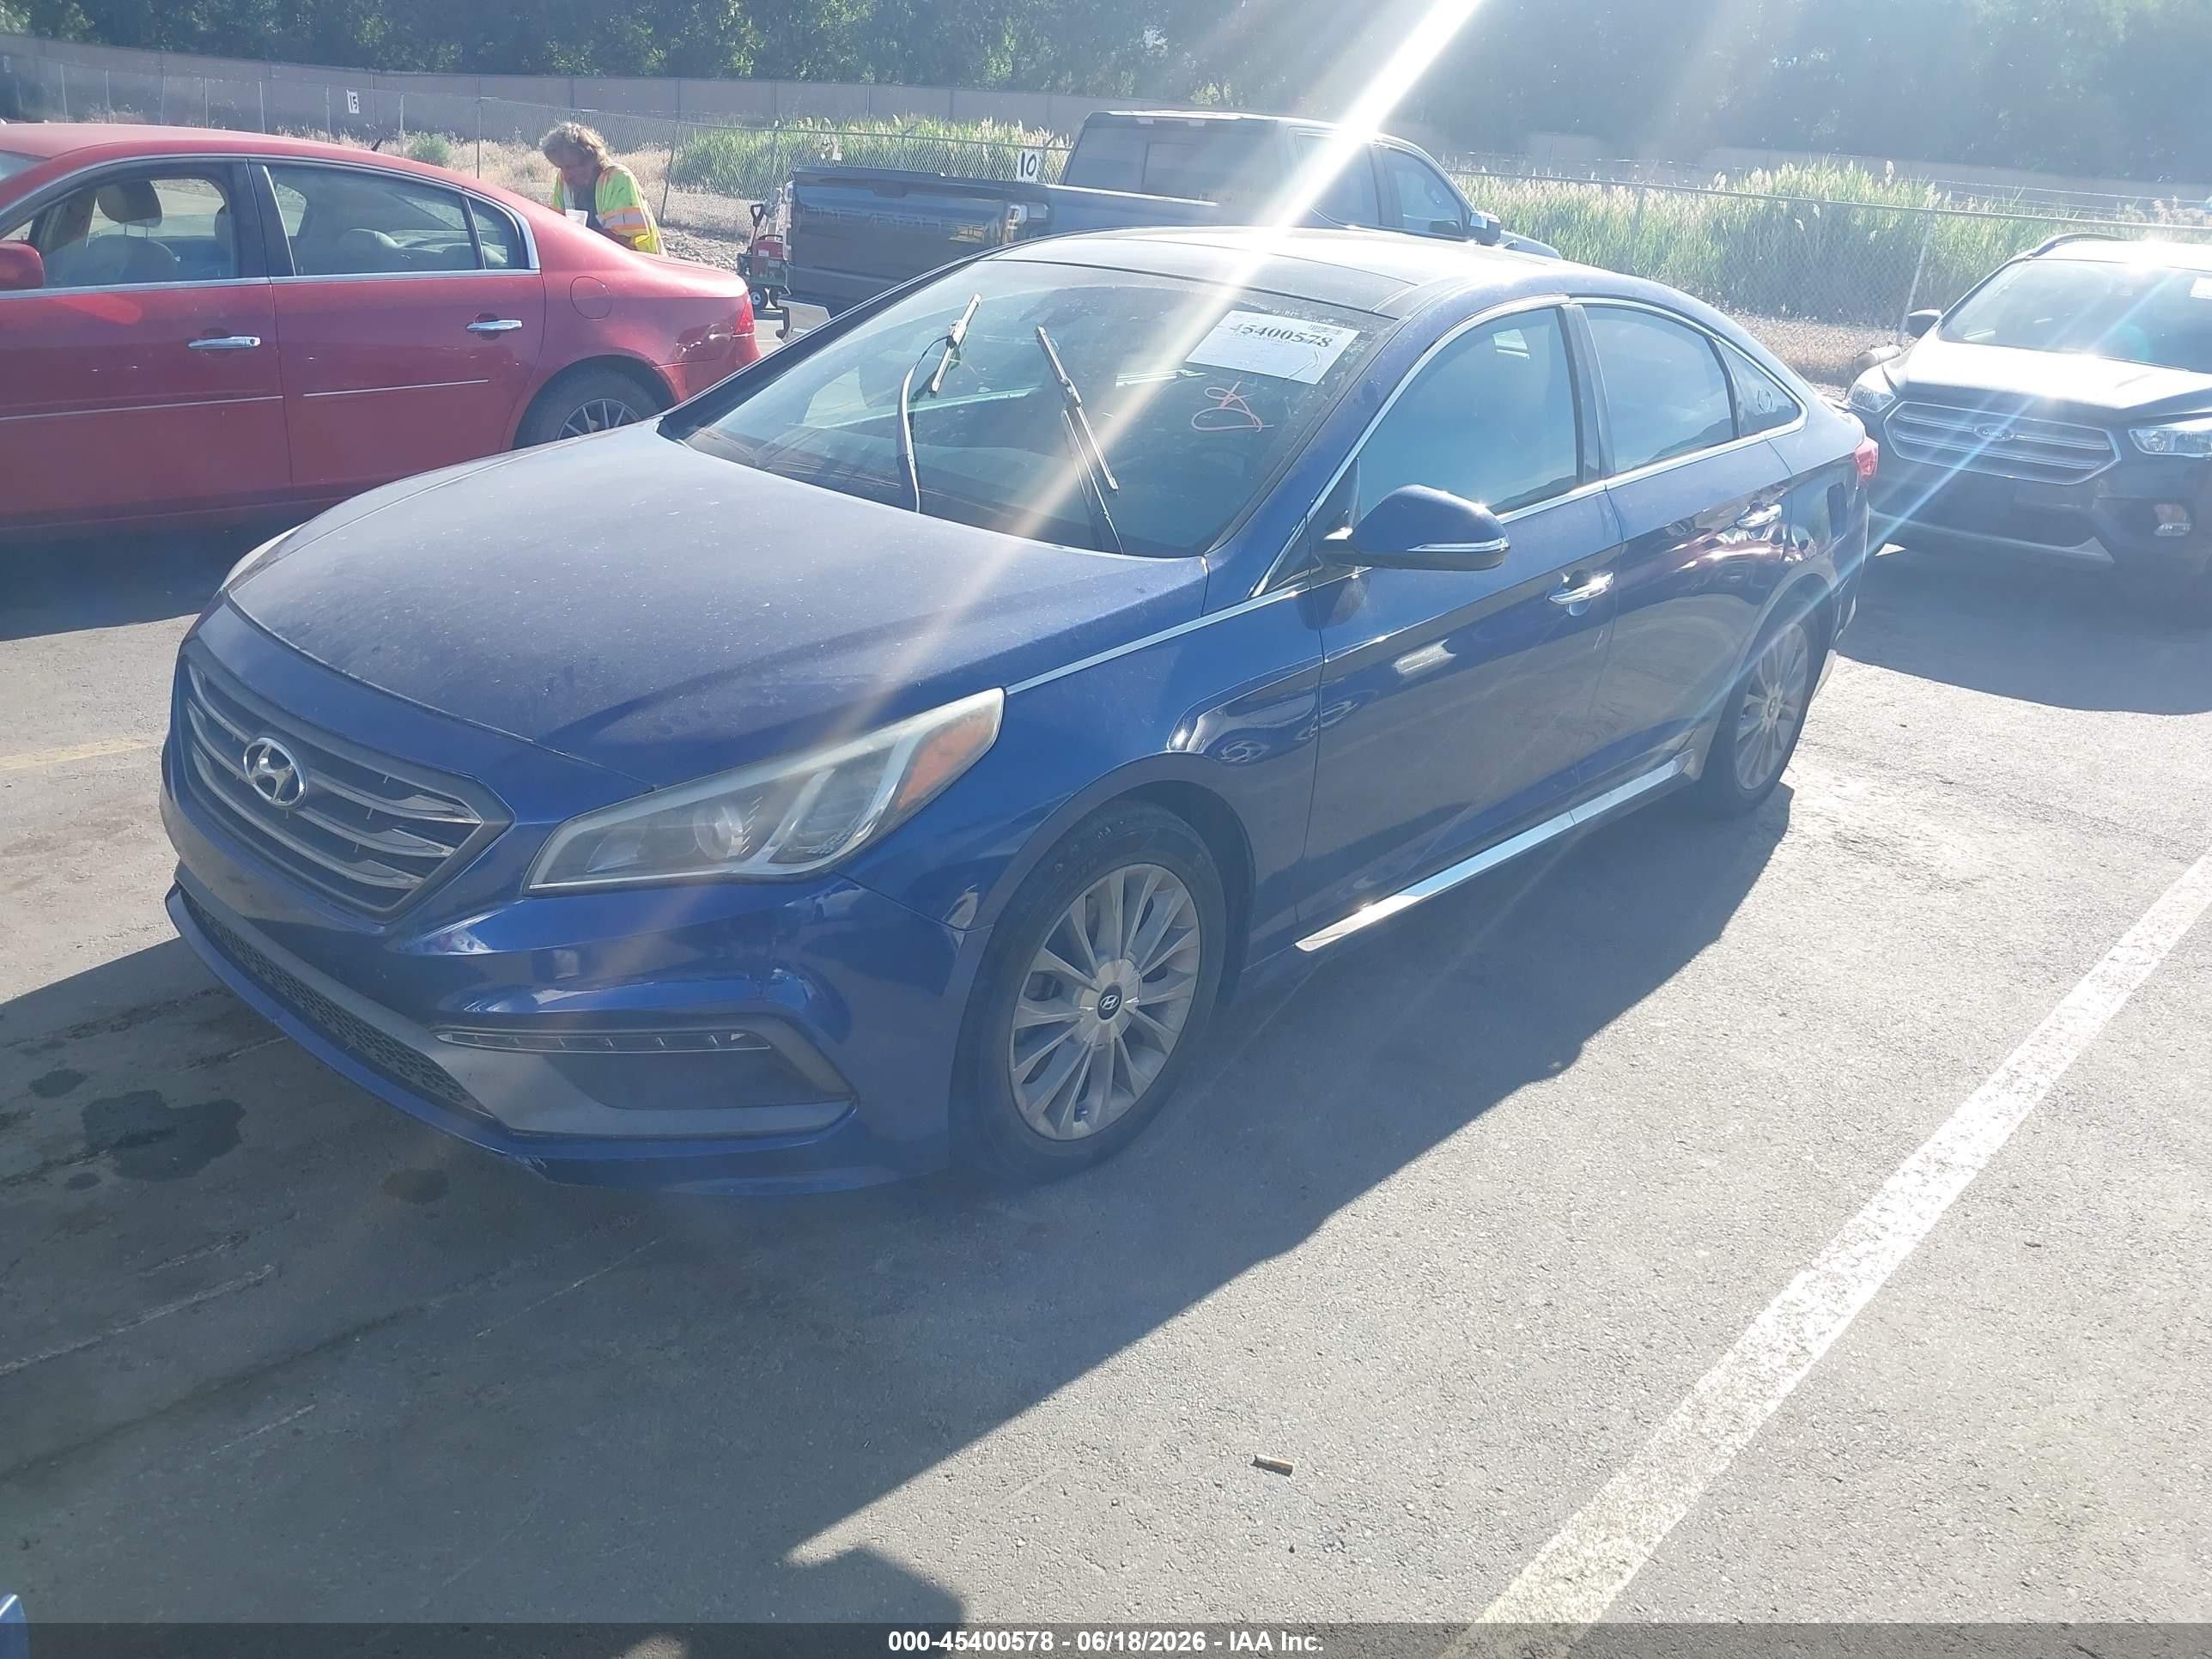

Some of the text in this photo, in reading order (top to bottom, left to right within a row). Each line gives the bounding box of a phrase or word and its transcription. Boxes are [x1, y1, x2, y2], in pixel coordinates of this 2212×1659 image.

[349, 94, 359, 111] 15
[1021, 151, 1037, 177] 10
[1229, 323, 1333, 348] 45400578
